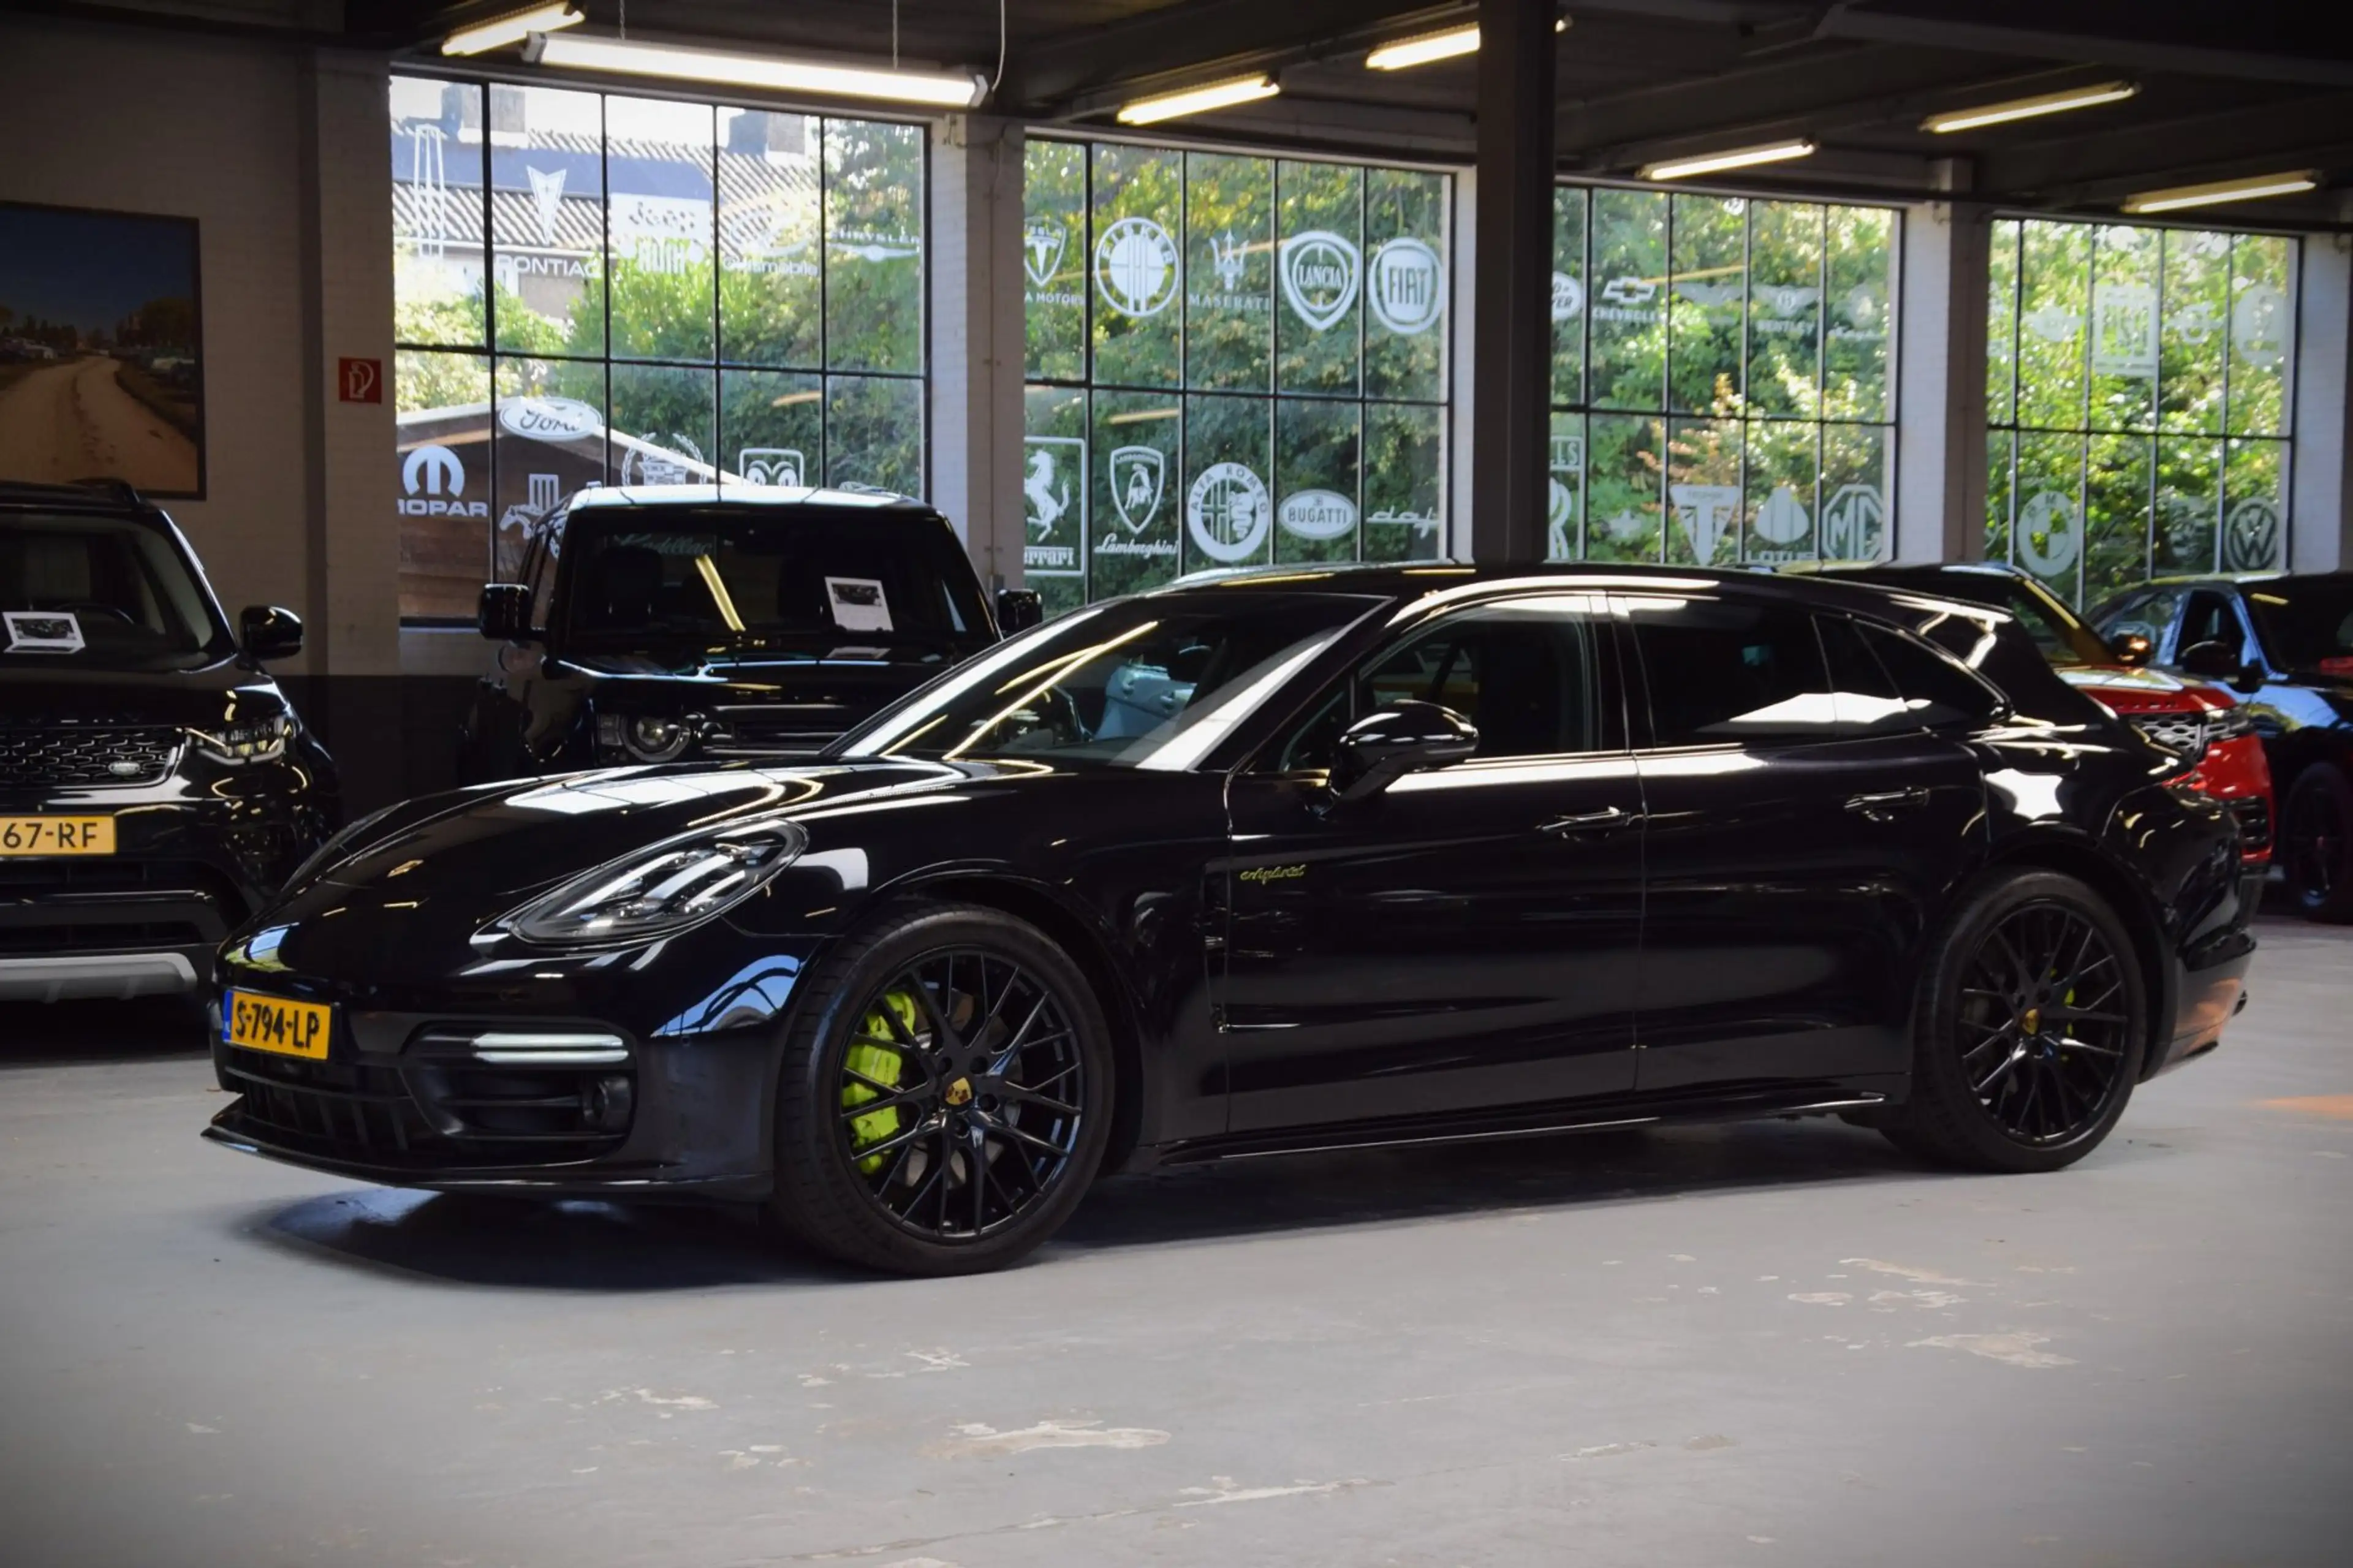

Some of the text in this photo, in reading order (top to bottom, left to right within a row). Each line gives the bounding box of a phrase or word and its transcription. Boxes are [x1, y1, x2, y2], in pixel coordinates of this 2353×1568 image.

[495, 253, 601, 279] PONTIAC
[1298, 265, 1343, 287] LANCIA
[1388, 267, 1430, 305] FIAT
[1188, 294, 1270, 311] MASERATI
[1191, 469, 1214, 512] ALFA
[1226, 464, 1268, 513] ROMEO
[1288, 506, 1347, 525] BUGATTI
[1094, 532, 1180, 560] Lamborghini
[2, 822, 98, 849] 67-RF
[235, 999, 320, 1050] S-794-LP
